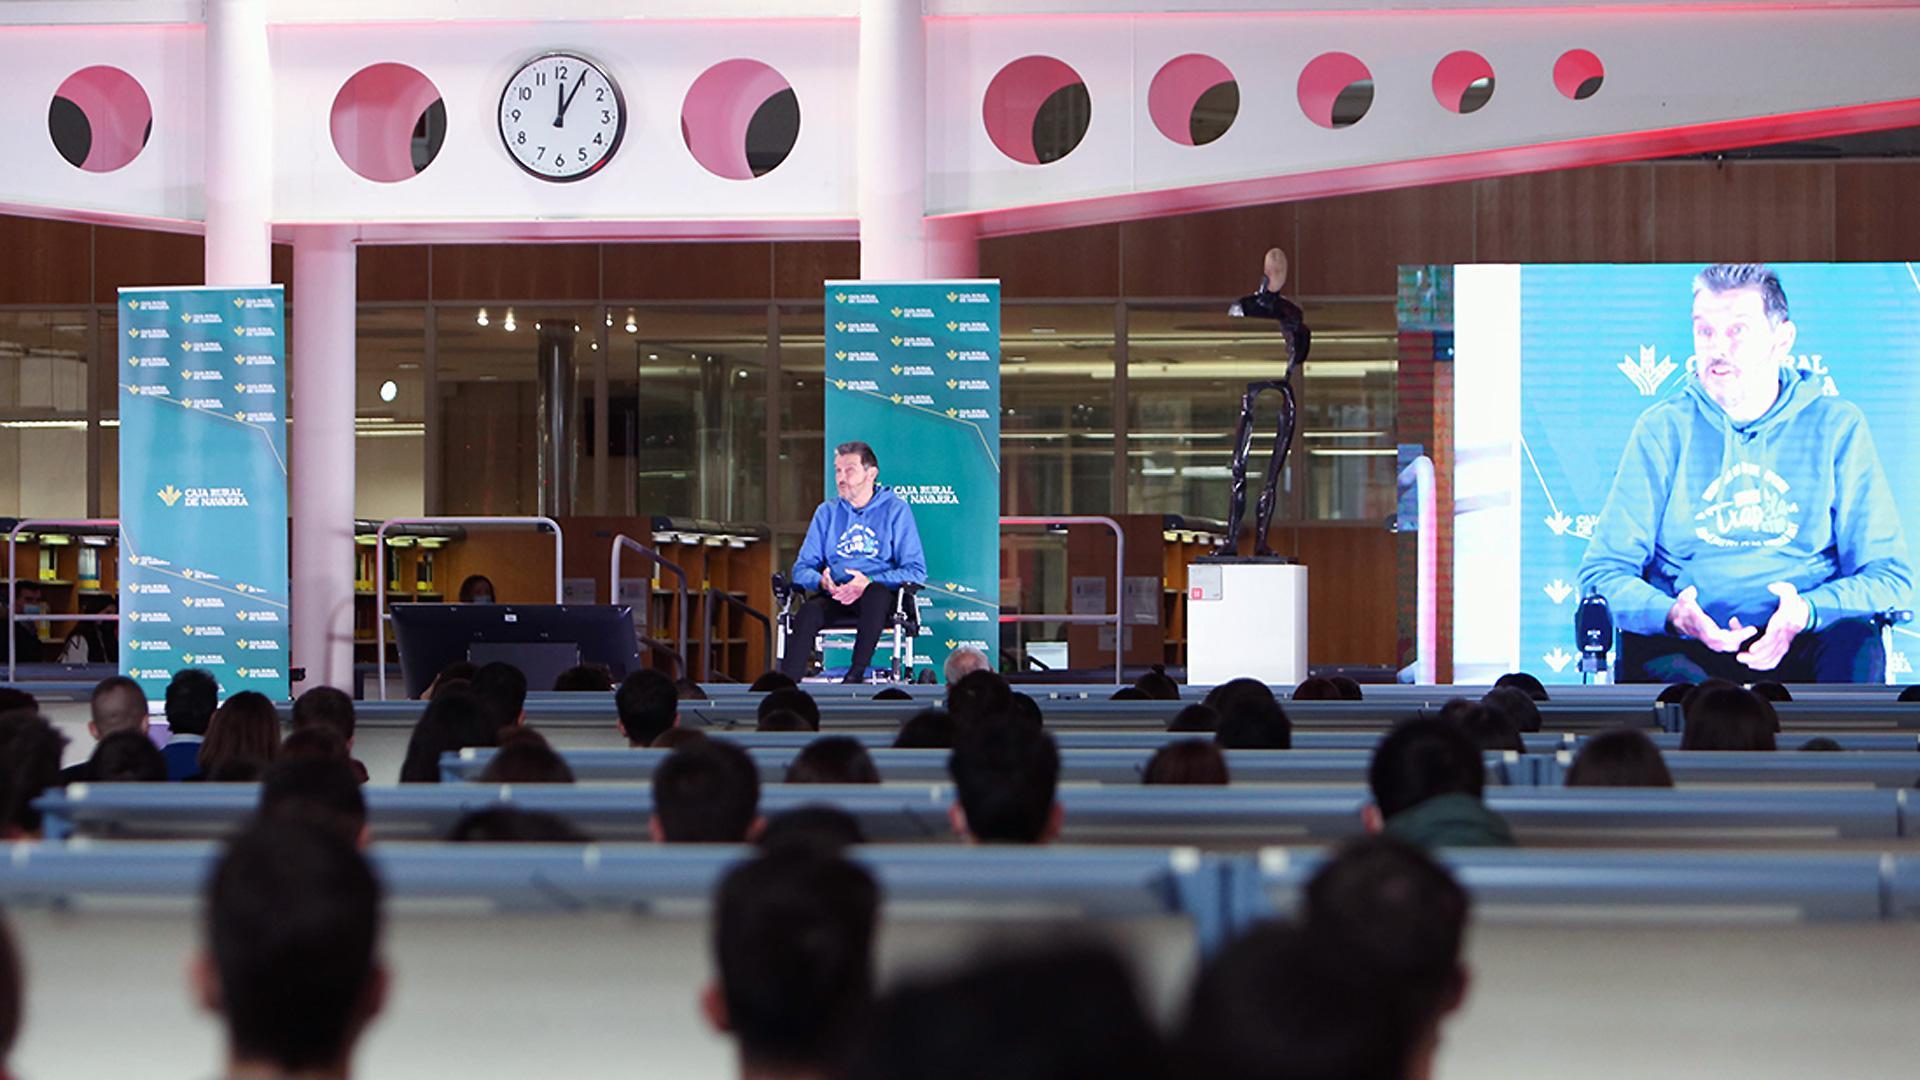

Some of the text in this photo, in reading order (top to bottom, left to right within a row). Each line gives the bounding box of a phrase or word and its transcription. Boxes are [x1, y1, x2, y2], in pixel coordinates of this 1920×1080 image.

[536, 73, 546, 86] 11
[555, 66, 568, 80] 12
[518, 87, 532, 101] 10
[595, 87, 605, 102] 2
[511, 109, 521, 123] 9
[601, 110, 611, 125] 3
[517, 131, 527, 145] 8
[592, 132, 603, 145] 4
[538, 146, 546, 160] 7
[555, 153, 565, 167] 6
[578, 147, 587, 161] 5
[184, 488, 208, 497] CAJA
[893, 485, 955, 494] CAJA RURAL
[910, 494, 960, 504] NAVARRA
